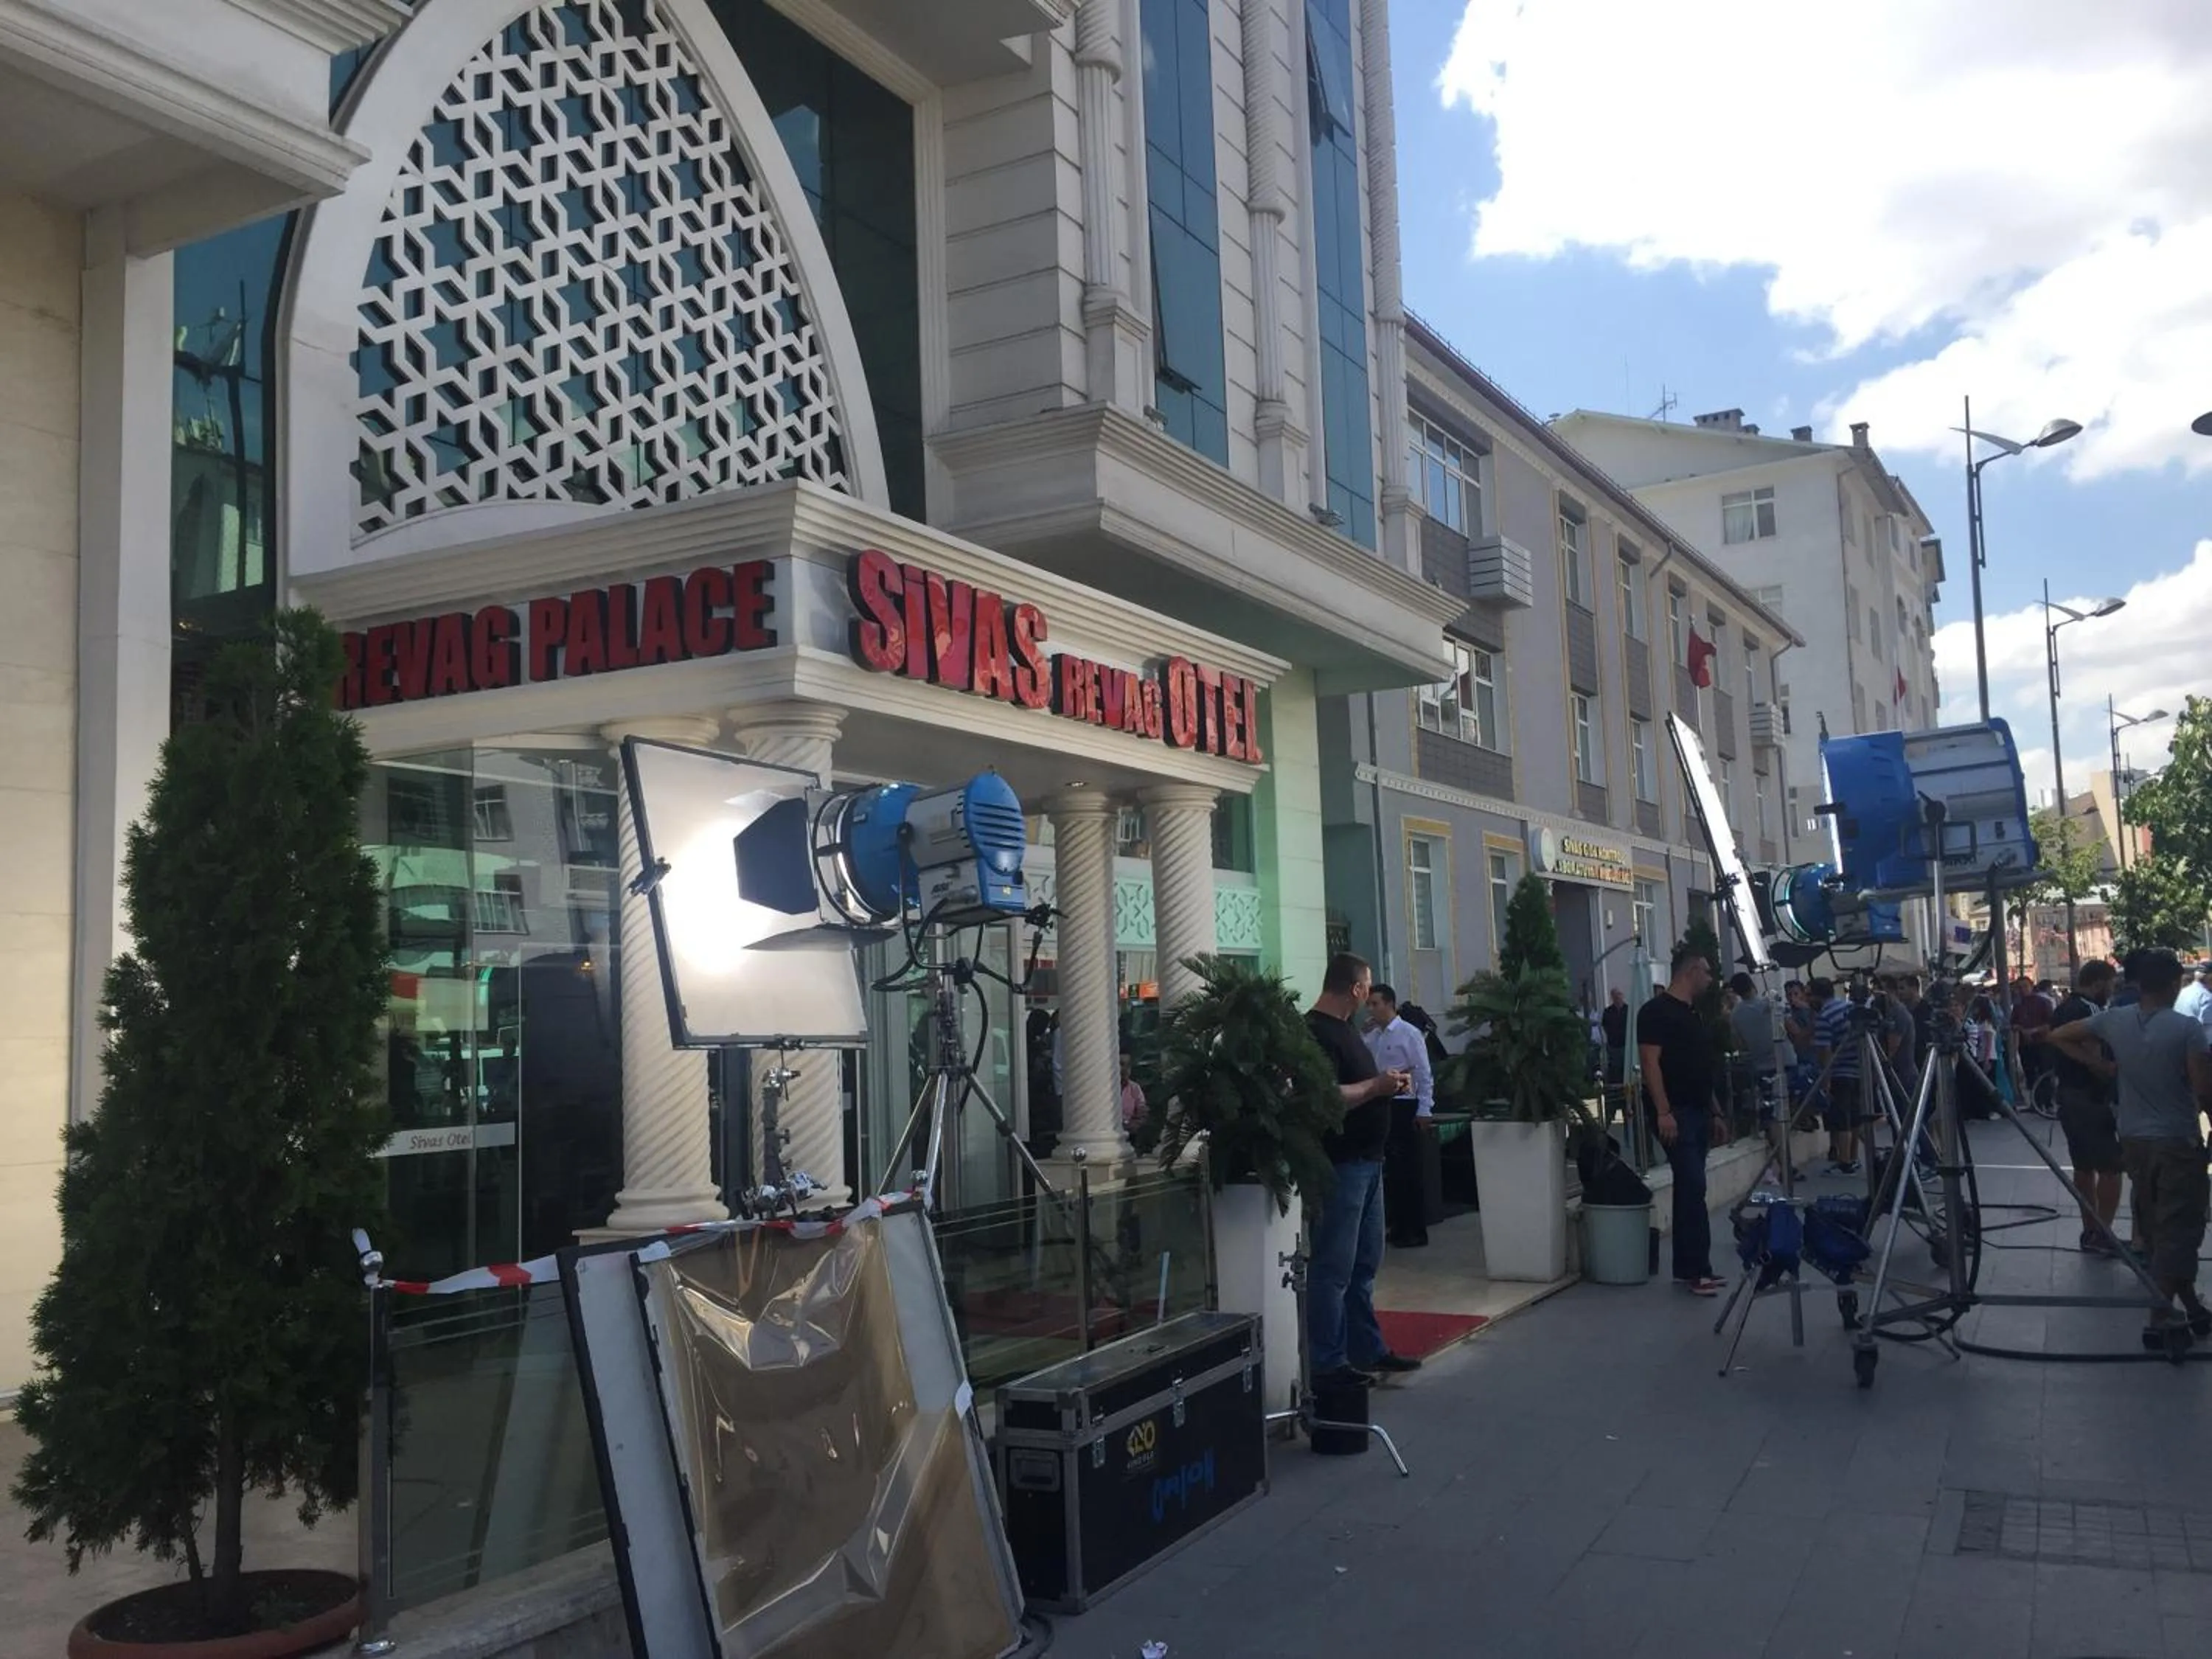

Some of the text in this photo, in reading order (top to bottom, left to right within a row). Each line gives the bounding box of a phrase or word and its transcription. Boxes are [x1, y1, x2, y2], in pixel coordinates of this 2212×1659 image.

[334, 560, 776, 710] REVAG PALACE
[1053, 653, 1161, 740] REVAG
[1161, 655, 1263, 765] OTEL
